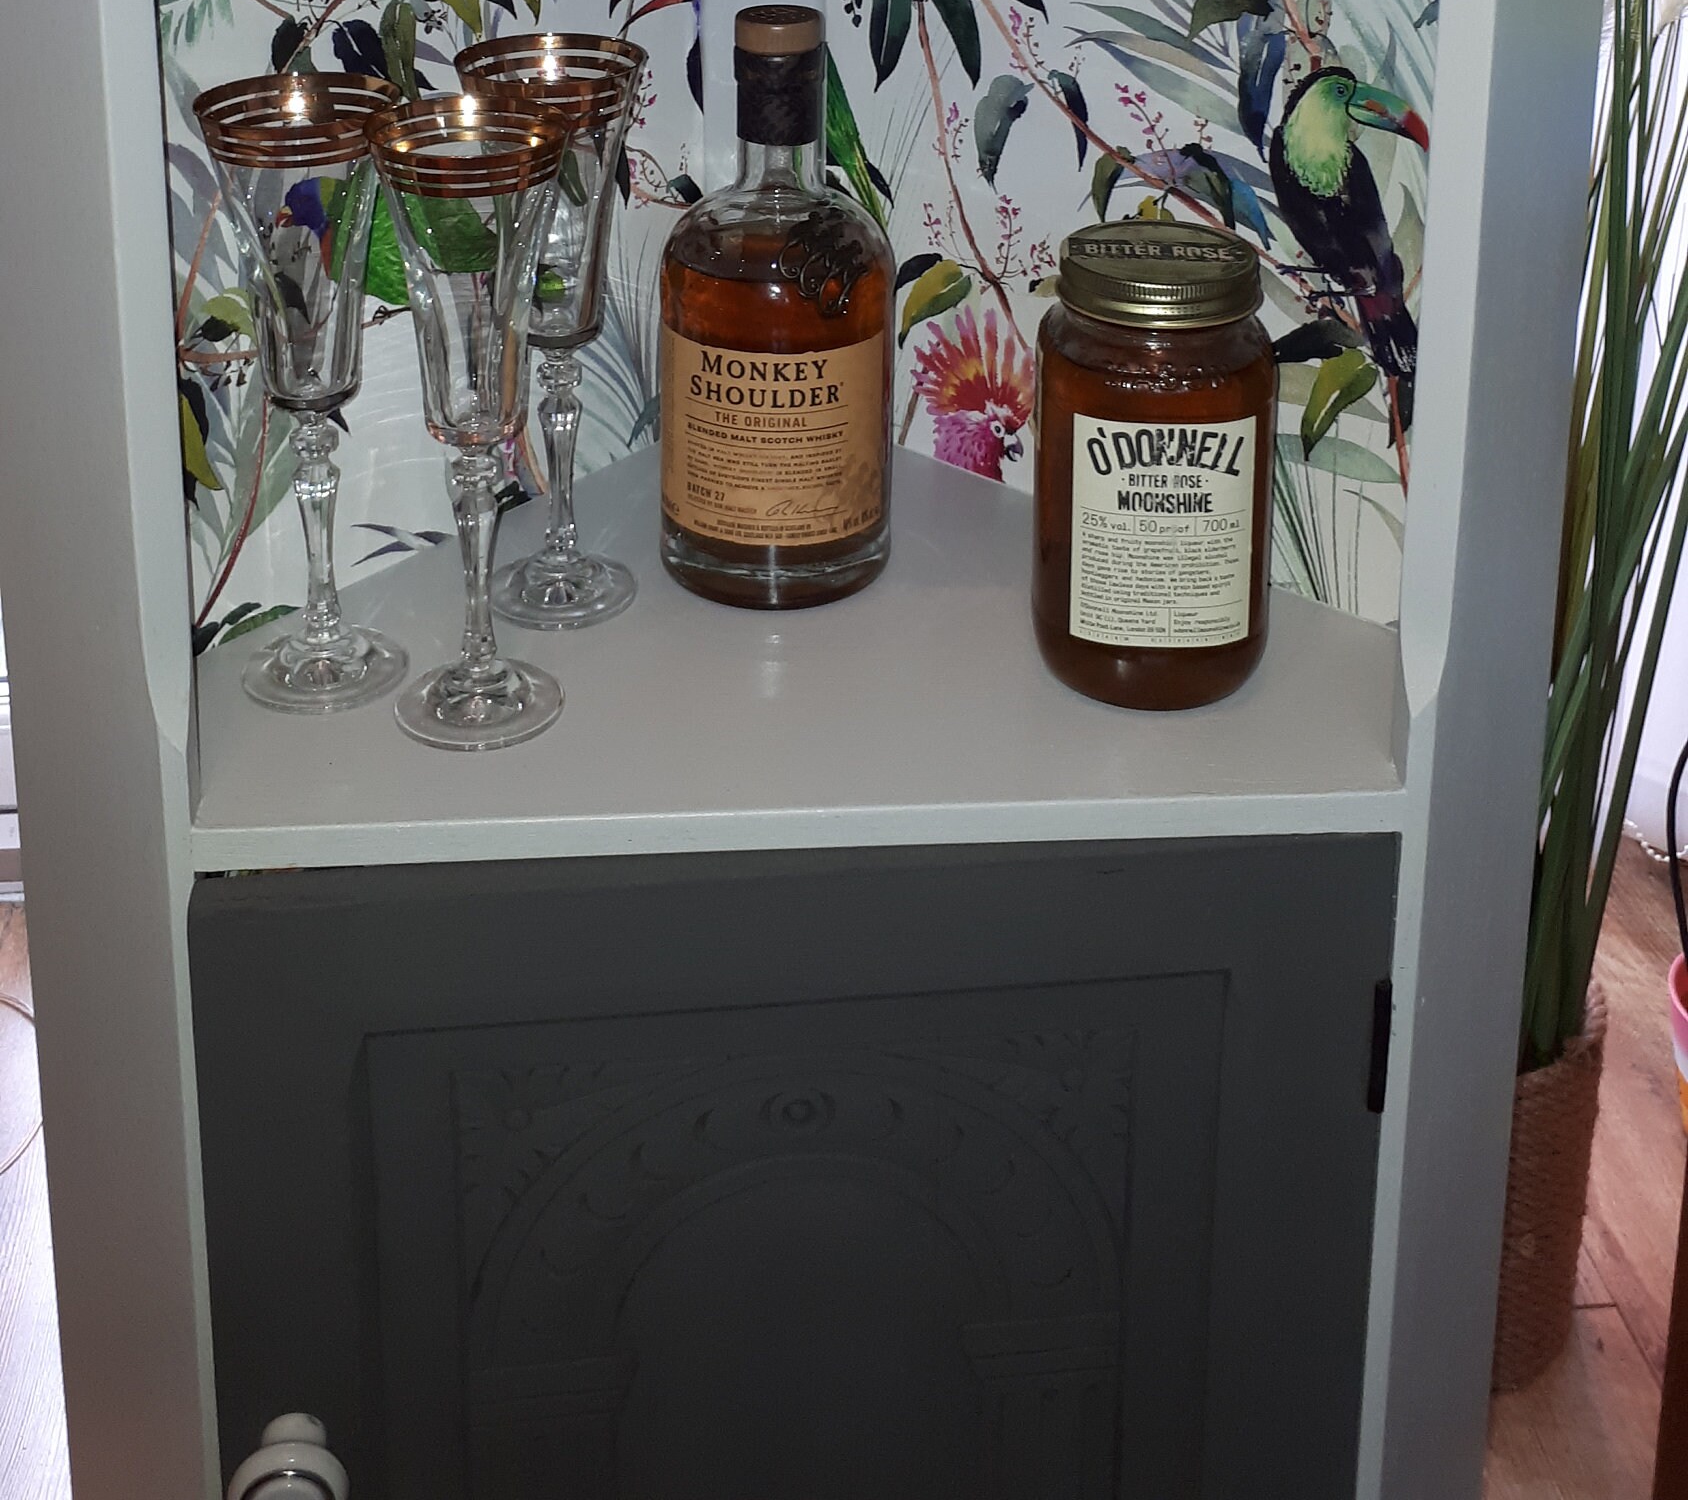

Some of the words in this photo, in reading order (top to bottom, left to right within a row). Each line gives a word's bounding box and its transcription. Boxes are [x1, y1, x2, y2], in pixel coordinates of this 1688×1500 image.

[1084, 242, 1162, 256] BITTER
[1172, 245, 1234, 260] ROSE
[701, 350, 828, 382] MONKEY
[690, 375, 840, 409] SHOULDER
[714, 411, 738, 426] THE
[744, 416, 808, 429] ORIGINAL
[687, 422, 728, 439] BLENDED
[731, 434, 758, 444] MALT
[760, 437, 803, 445] SCOTCH
[806, 430, 844, 443] WHISKY
[1086, 426, 1245, 477] O'DONNELL
[687, 481, 712, 498] BATCH
[714, 490, 725, 501] 27
[1128, 473, 1168, 488] BITTER
[1117, 490, 1214, 514] MOONSHINE
[1082, 512, 1108, 529] 25%
[1110, 521, 1132, 532] vol.
[1139, 519, 1157, 533] 50
[1159, 523, 1190, 535] prof
[1202, 518, 1228, 532] 700
[1229, 518, 1240, 529] ml
